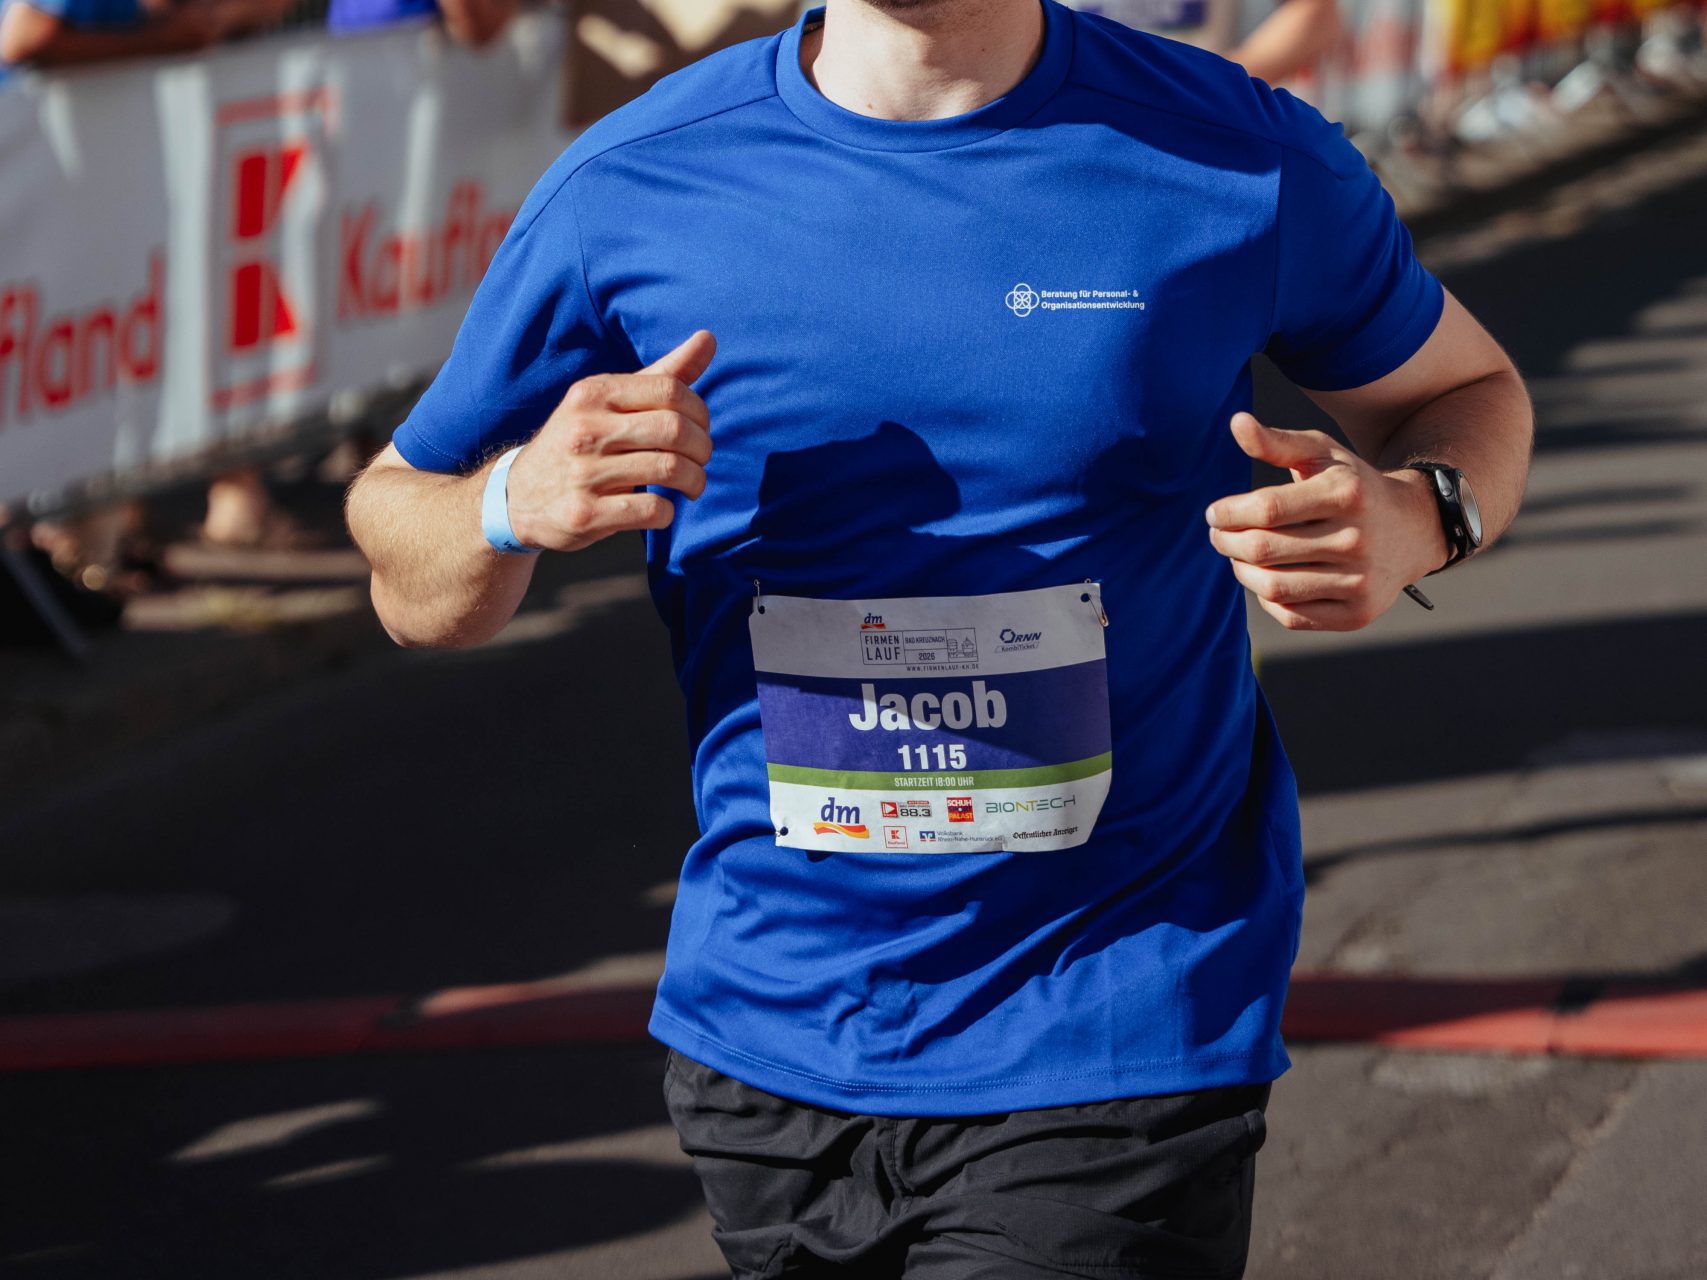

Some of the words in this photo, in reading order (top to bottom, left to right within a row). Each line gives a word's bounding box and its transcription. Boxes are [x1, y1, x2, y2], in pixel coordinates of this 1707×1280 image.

[1041, 290, 1078, 300] Beratung
[1079, 289, 1091, 298] für
[1092, 289, 1131, 298] Personal-
[1132, 289, 1139, 298] &
[1041, 301, 1145, 311] Organisationsentwicklung
[864, 612, 883, 624] dm
[864, 635, 900, 645] FIRMEN
[866, 646, 901, 661] LAUF
[848, 681, 1008, 731] Jacob
[898, 744, 967, 770] 1115
[894, 777, 933, 787] STARTZEIT
[935, 777, 956, 787] 18:00
[957, 776, 975, 786] UHR
[947, 799, 972, 807] SCHUH
[820, 797, 860, 825] dm
[900, 808, 931, 817] 88.3
